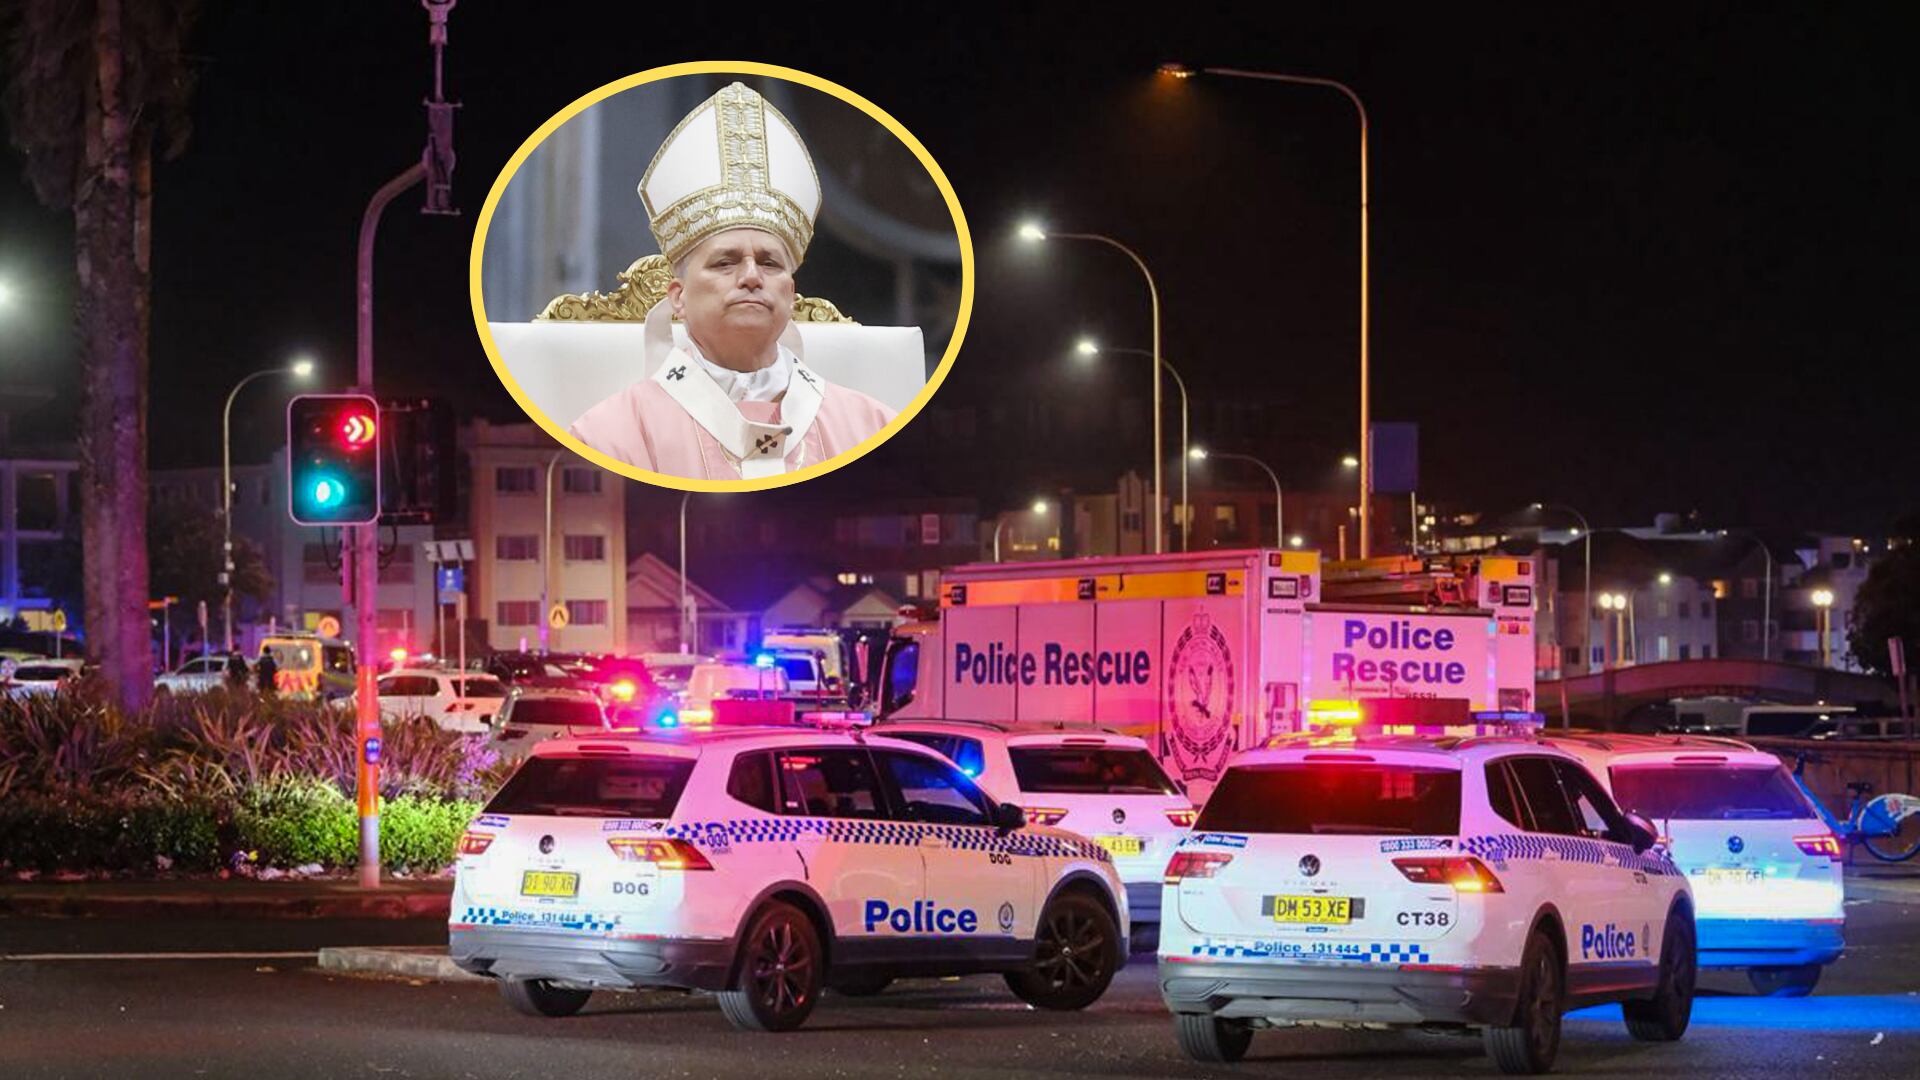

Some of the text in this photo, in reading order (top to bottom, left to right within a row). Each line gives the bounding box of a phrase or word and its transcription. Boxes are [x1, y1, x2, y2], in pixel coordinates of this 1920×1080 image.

[1344, 620, 1455, 651] Police
[955, 642, 1036, 685] Police
[1044, 643, 1151, 686] Rescue
[1332, 653, 1466, 684] Rescue
[707, 832, 728, 848] 000
[988, 853, 1012, 865] DOG
[612, 881, 649, 896] DOG
[502, 910, 534, 921] Police
[865, 900, 978, 933] Police
[1277, 899, 1347, 918] DM 53 XE
[1396, 912, 1449, 926] CT38
[1254, 941, 1302, 952] Police
[1582, 923, 1636, 959] Police
